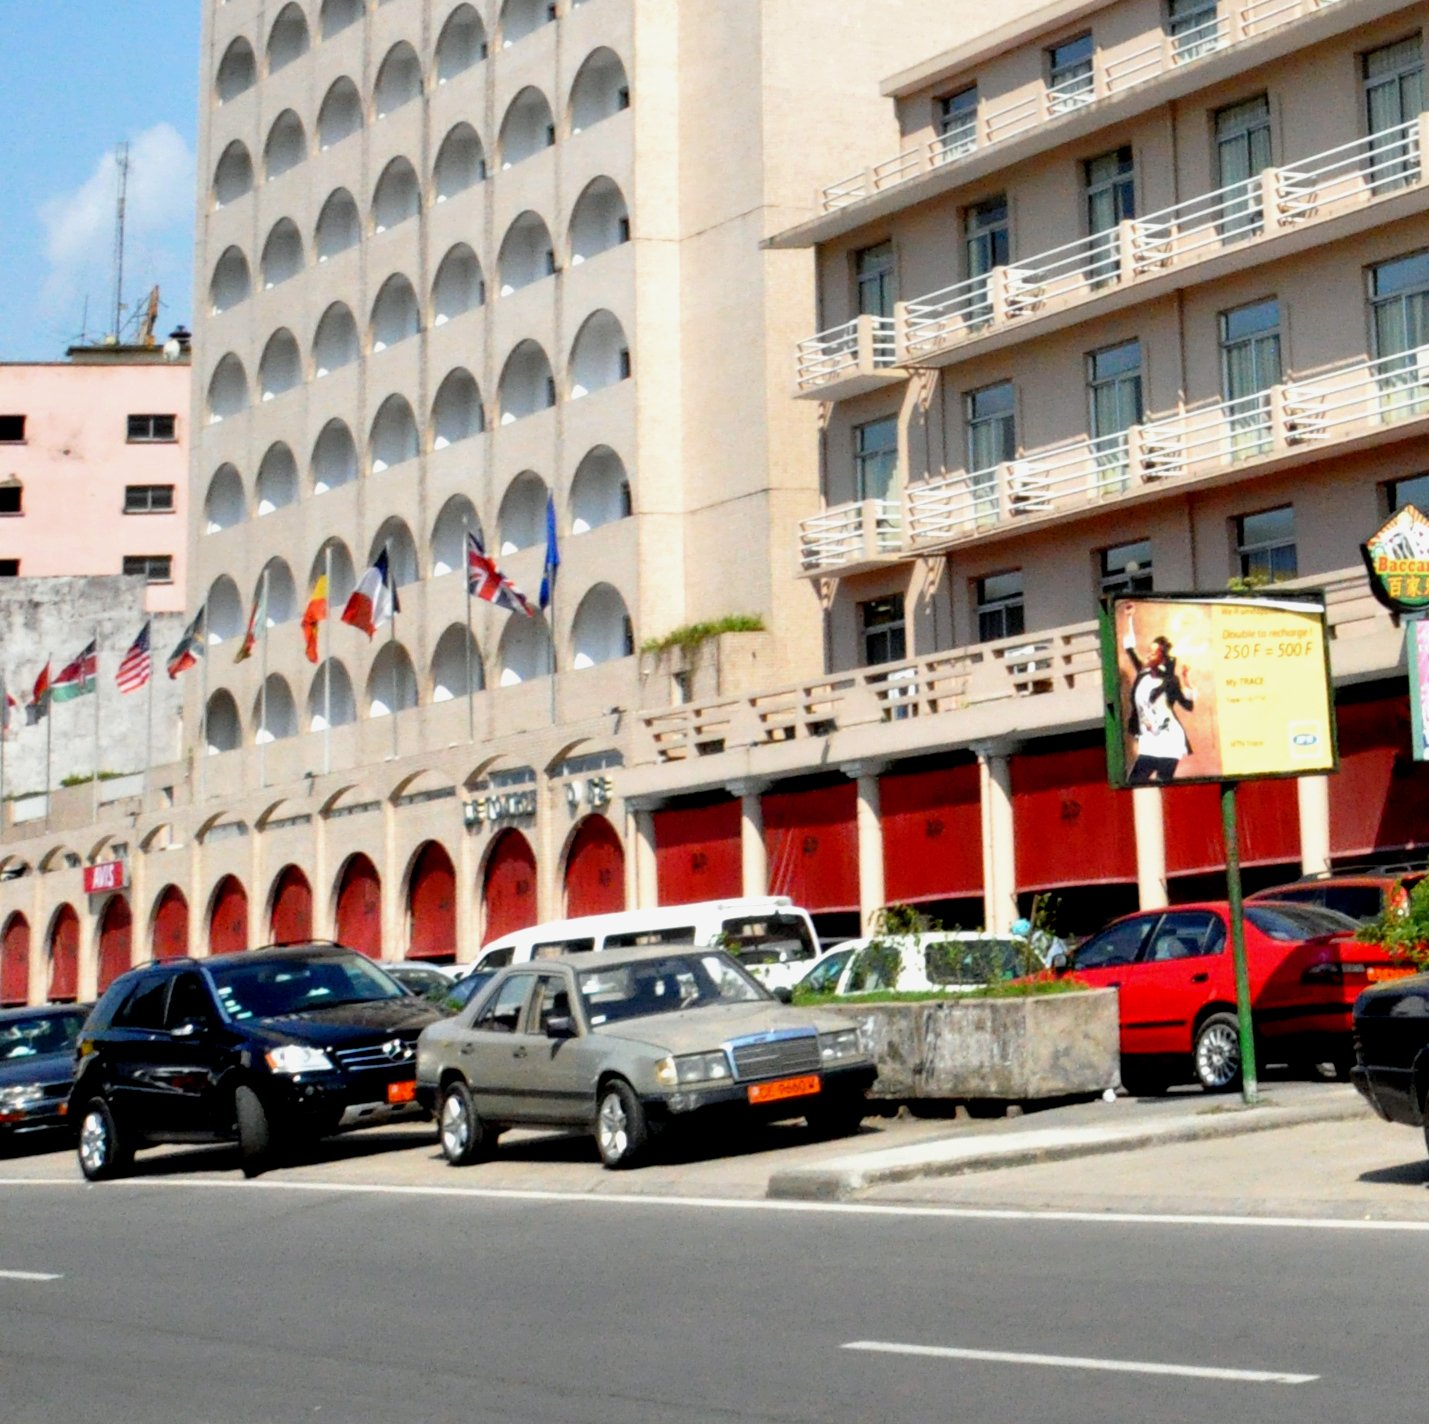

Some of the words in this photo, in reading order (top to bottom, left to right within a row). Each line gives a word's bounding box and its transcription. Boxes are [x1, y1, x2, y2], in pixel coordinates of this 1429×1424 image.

[1224, 644, 1250, 659] 250
[1254, 643, 1261, 654] F
[1278, 642, 1302, 658] 500
[1305, 641, 1313, 655] F
[92, 864, 115, 888] AVIS
